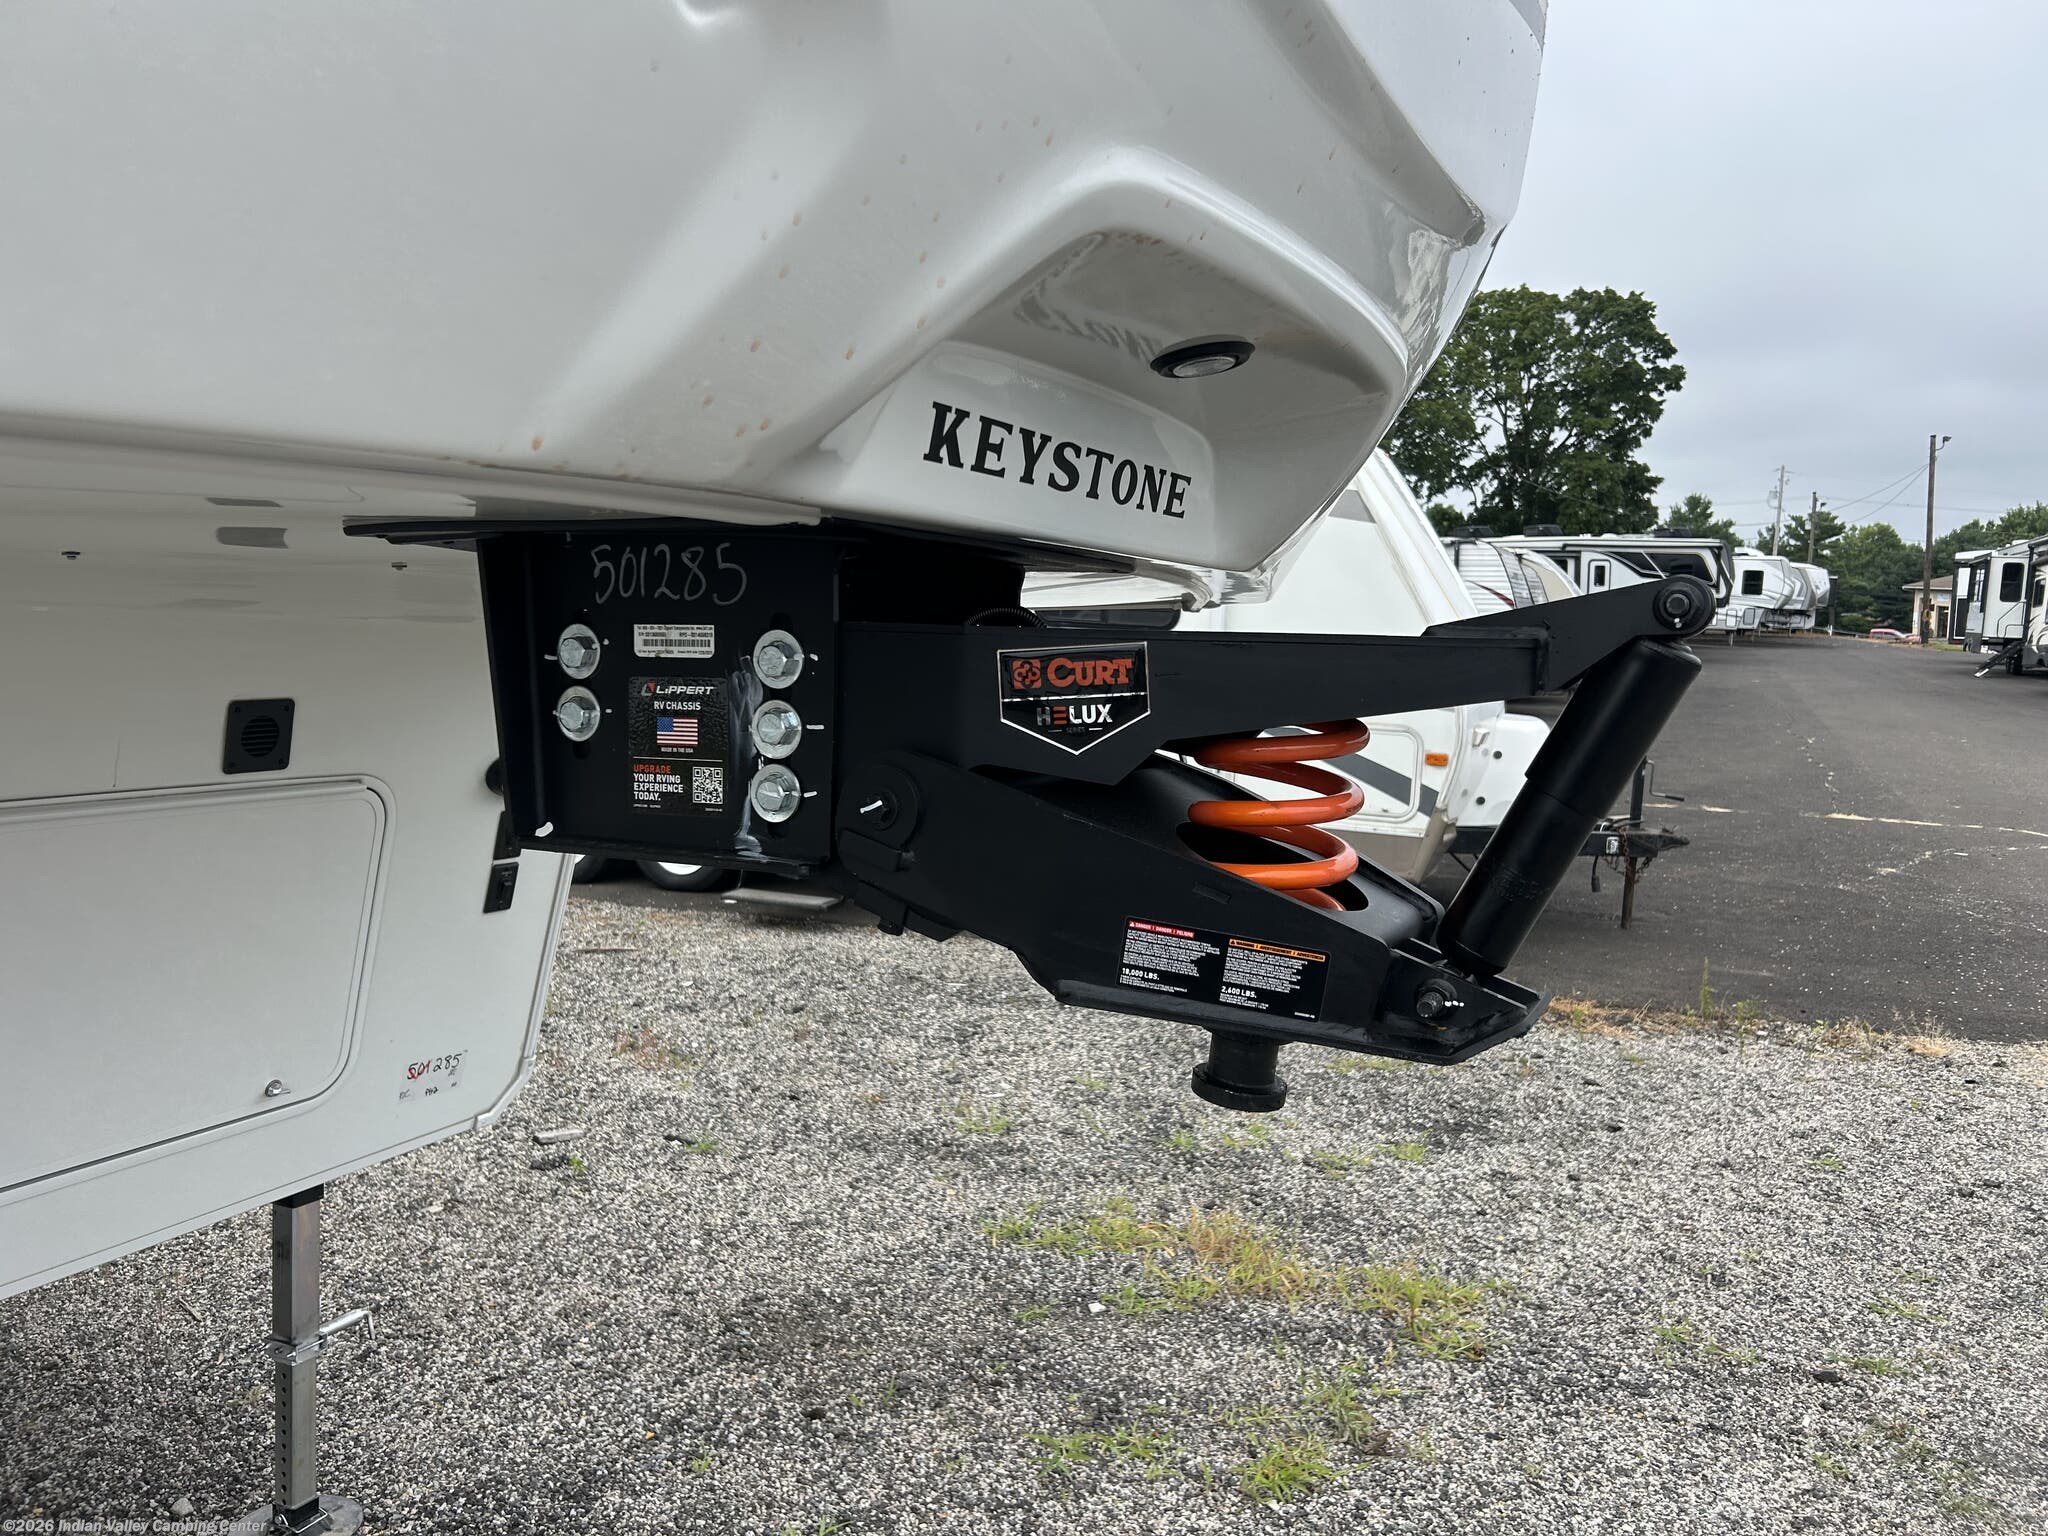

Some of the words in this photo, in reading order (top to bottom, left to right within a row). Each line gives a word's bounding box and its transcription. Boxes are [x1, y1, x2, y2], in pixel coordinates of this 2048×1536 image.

[922, 401, 1192, 519] KEYSTONE
[590, 542, 748, 606] 501285
[1047, 656, 1133, 688] CURT
[654, 701, 665, 710] RV
[666, 701, 702, 711] CHASSIS
[1036, 703, 1113, 726] HELUX
[633, 764, 672, 774] UPGRADE
[633, 773, 655, 782] YOUR
[656, 774, 681, 783] RVING
[634, 782, 684, 793] EXPERIENCE
[634, 791, 661, 801] TODAY.
[1144, 971, 1160, 980] LBS.
[1241, 989, 1257, 999] LBS.
